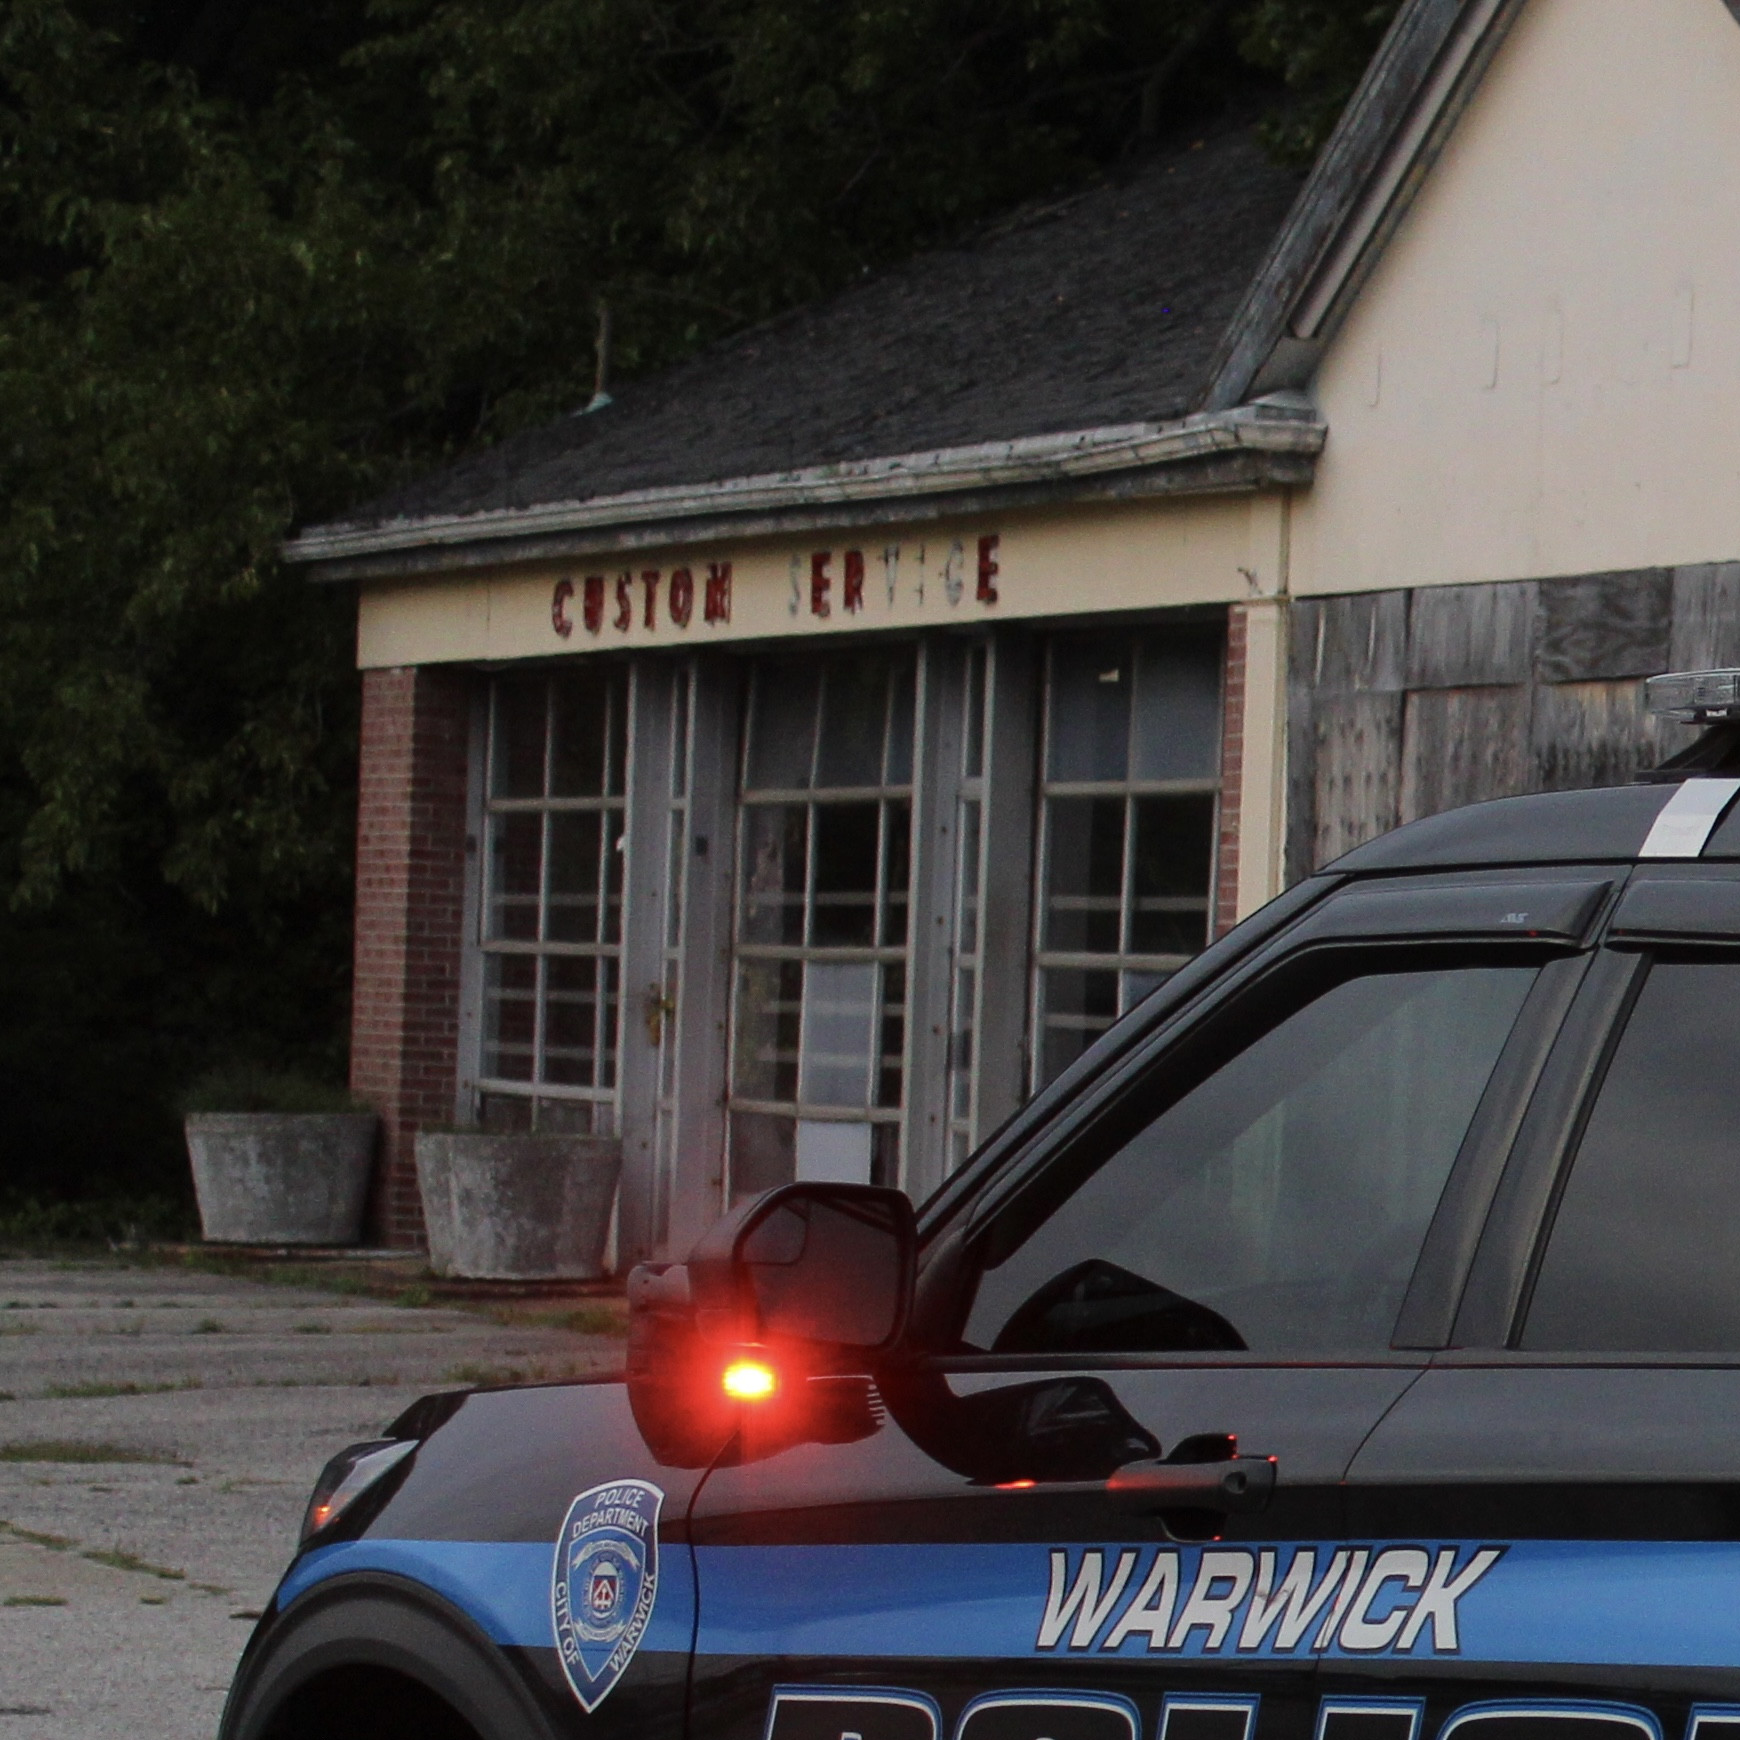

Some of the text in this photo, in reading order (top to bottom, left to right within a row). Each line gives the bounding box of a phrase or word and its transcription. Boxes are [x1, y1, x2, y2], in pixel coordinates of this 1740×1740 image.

[552, 560, 734, 640] CUSTOM
[572, 1507, 650, 1538] DEPARTMENT
[593, 1488, 646, 1509] POLICE
[555, 1581, 580, 1666] CITY OF
[609, 1573, 656, 1672] WARWICK
[1033, 1544, 1512, 1656] WARWICK
